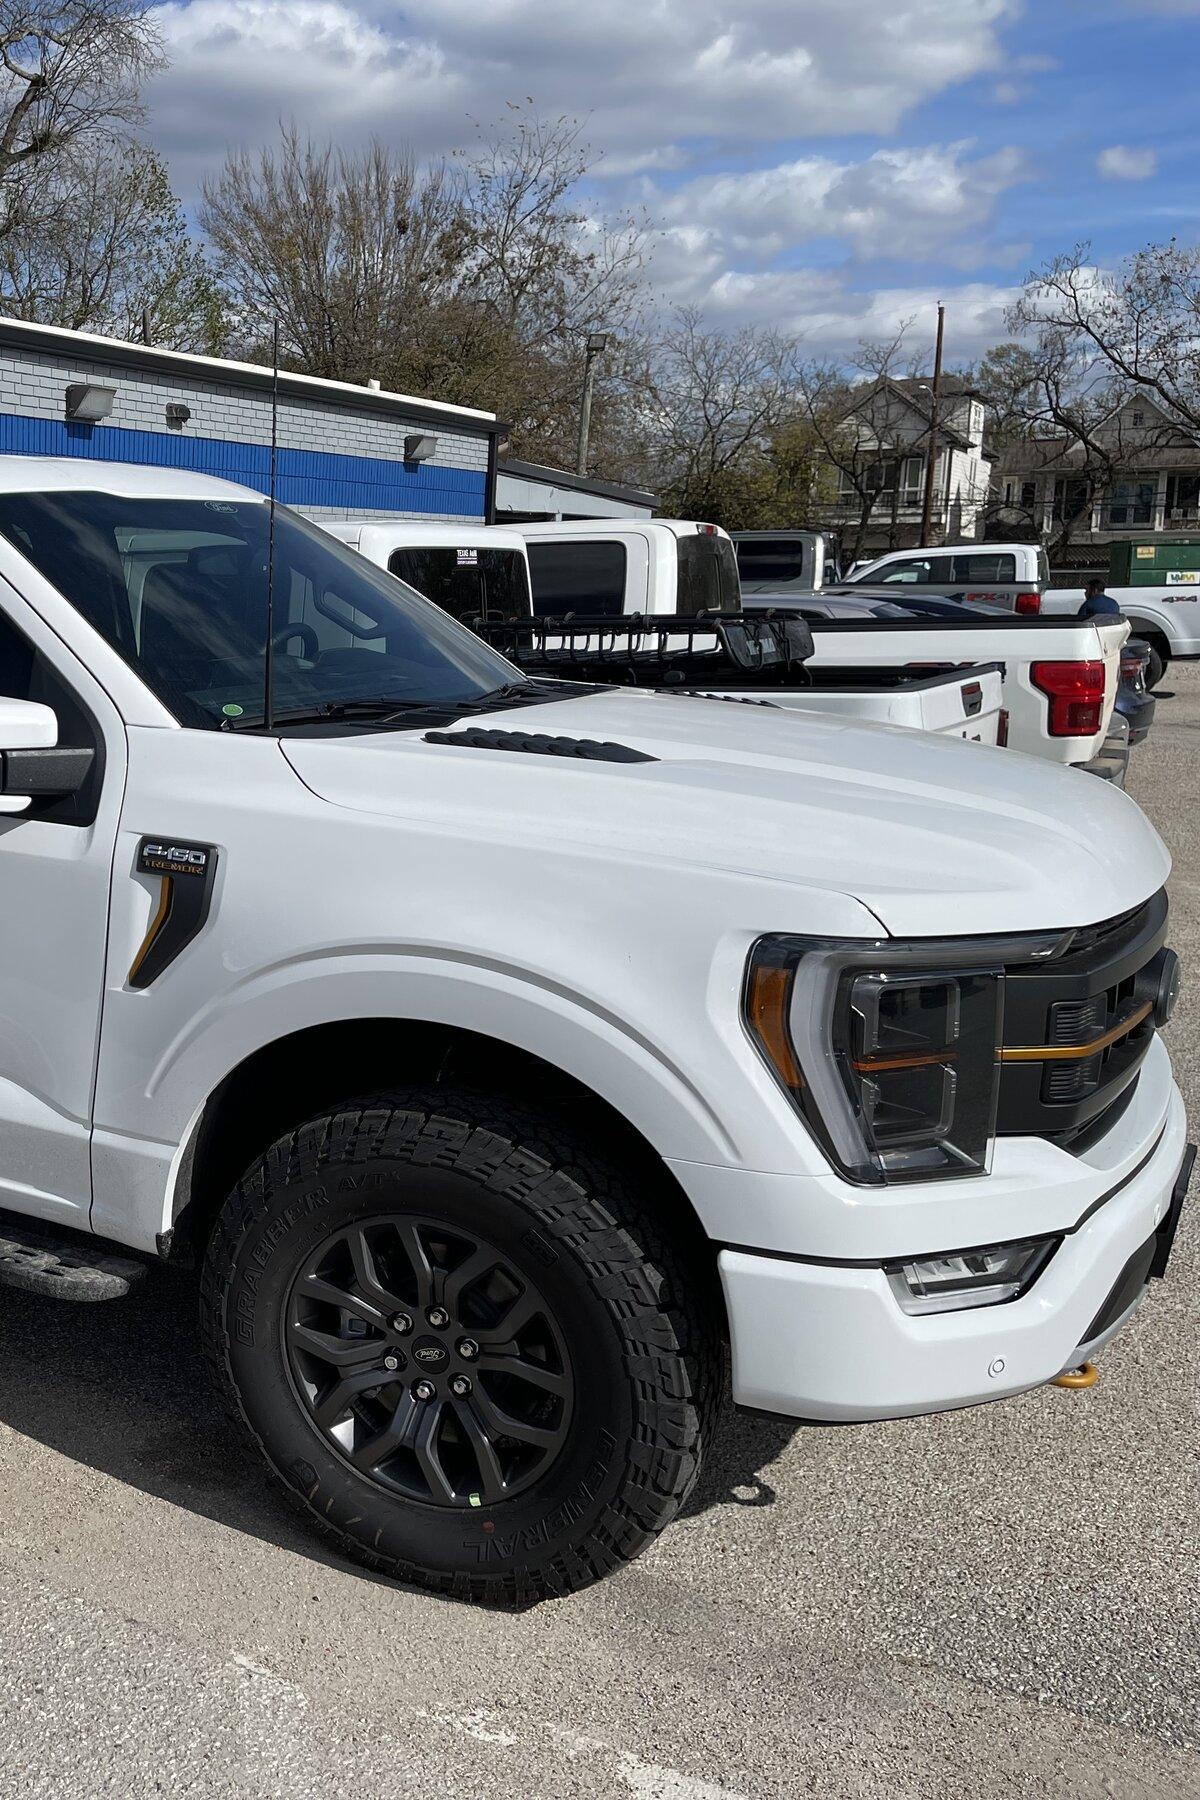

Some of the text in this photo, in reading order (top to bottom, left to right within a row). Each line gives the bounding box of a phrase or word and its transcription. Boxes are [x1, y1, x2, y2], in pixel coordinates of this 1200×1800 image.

[143, 844, 206, 865] F-150
[145, 860, 204, 875] TREMOR
[235, 1184, 331, 1348] GRABBER
